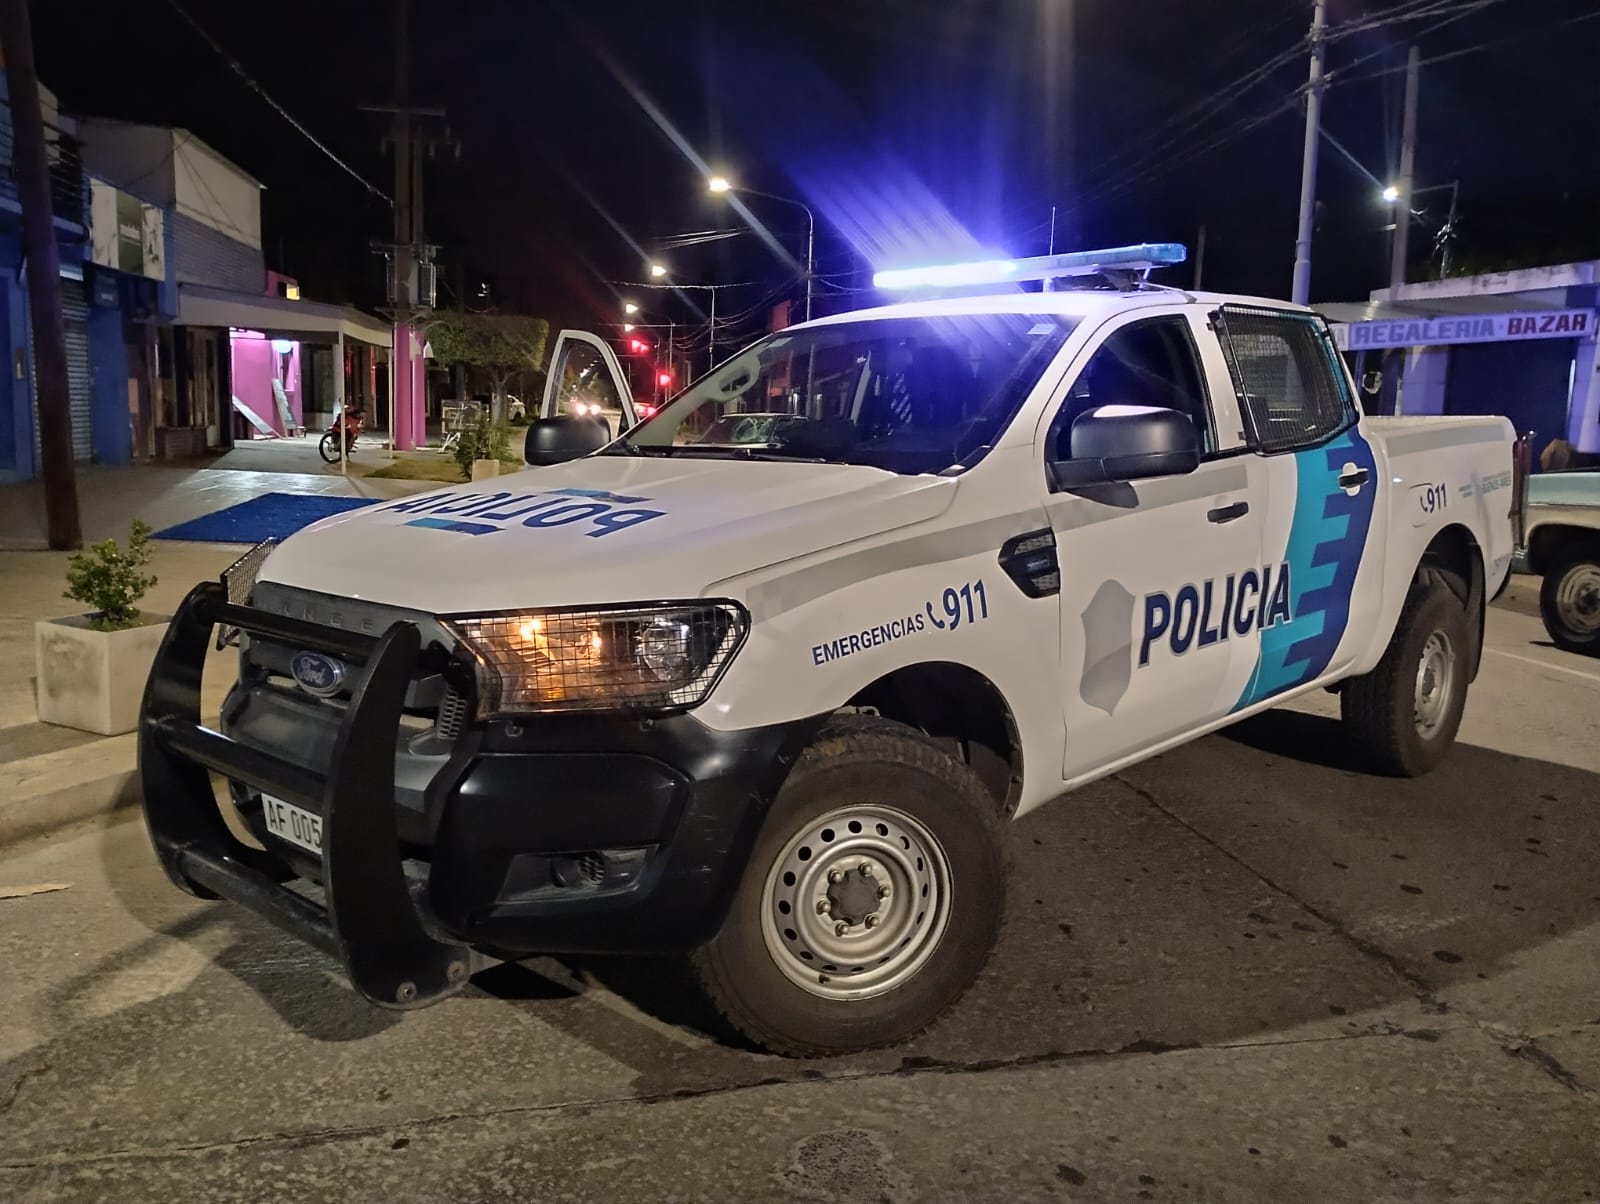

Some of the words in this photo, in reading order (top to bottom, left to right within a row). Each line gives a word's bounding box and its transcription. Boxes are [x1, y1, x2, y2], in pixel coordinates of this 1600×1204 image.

[1353, 317, 1496, 346] REGALERIA
[1506, 312, 1588, 336] BAZAR
[1426, 483, 1447, 514] 911
[811, 613, 925, 666] EMERGENCIAS
[942, 578, 989, 631] 911
[1138, 560, 1292, 669] POLICIA
[268, 800, 287, 831] AF
[290, 809, 322, 849] 005
